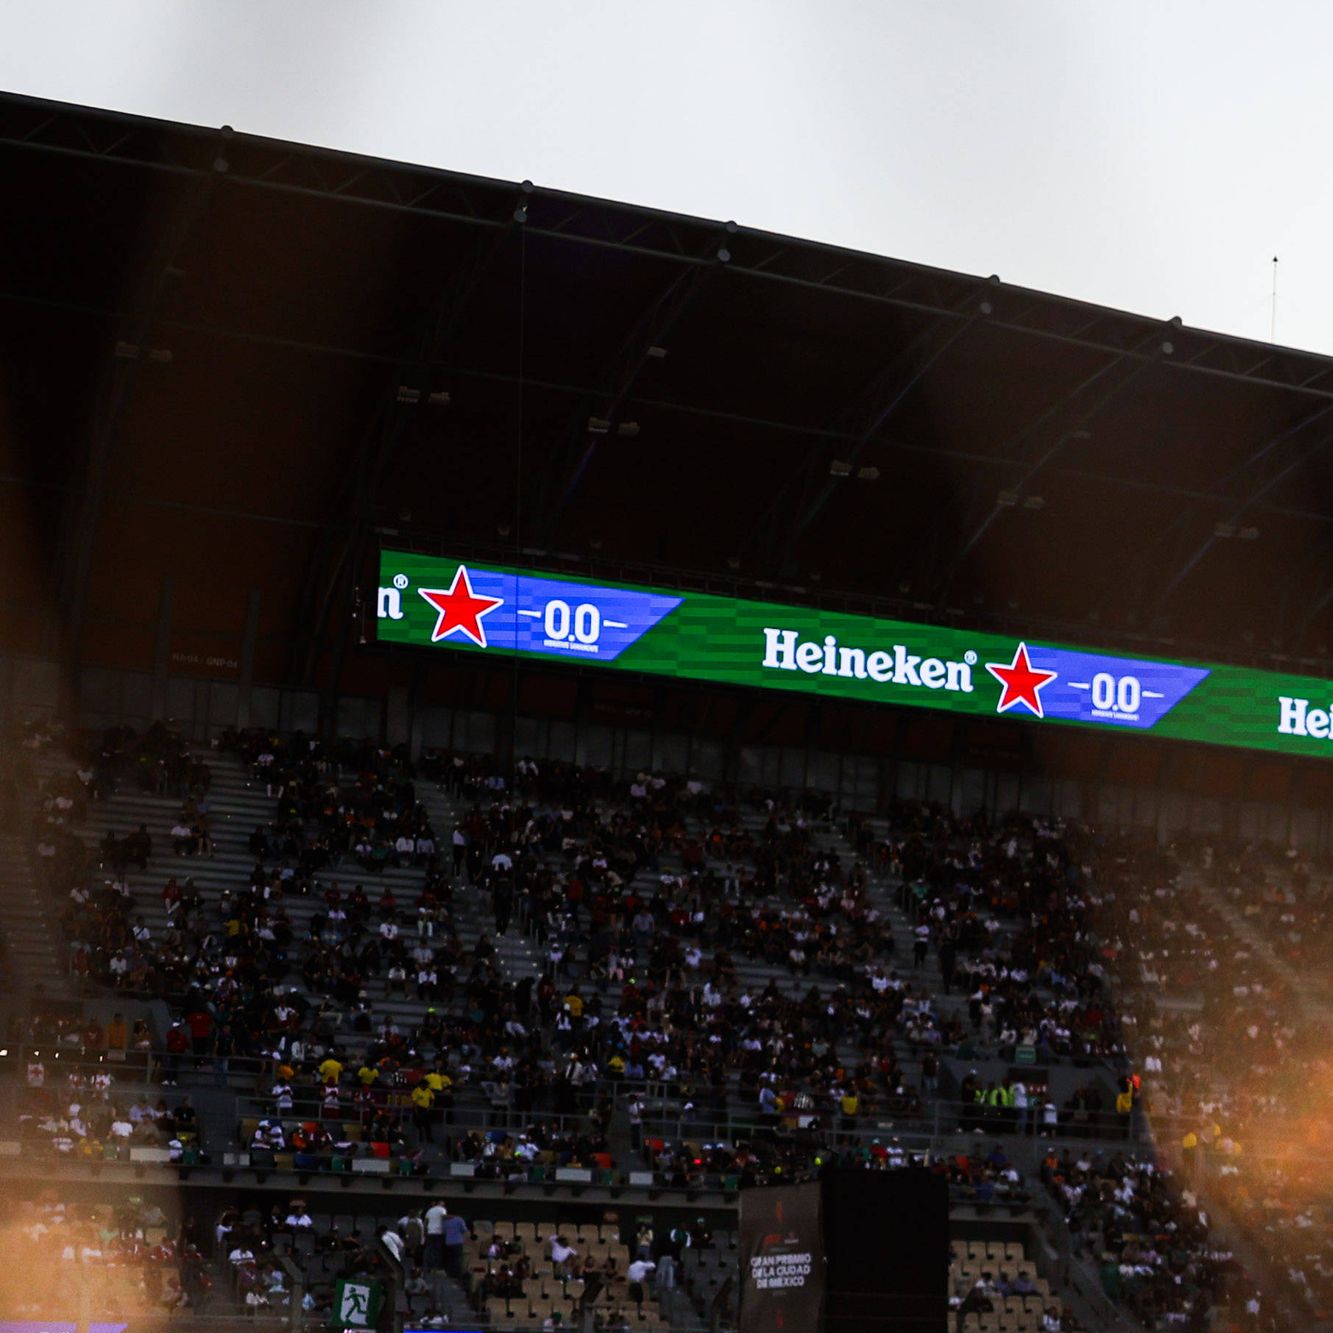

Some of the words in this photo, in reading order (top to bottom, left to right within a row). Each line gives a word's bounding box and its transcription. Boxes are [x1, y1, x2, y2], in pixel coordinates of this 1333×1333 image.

[544, 600, 600, 644] 0.0
[762, 628, 974, 692] Heineken
[1092, 672, 1141, 713] 0.0
